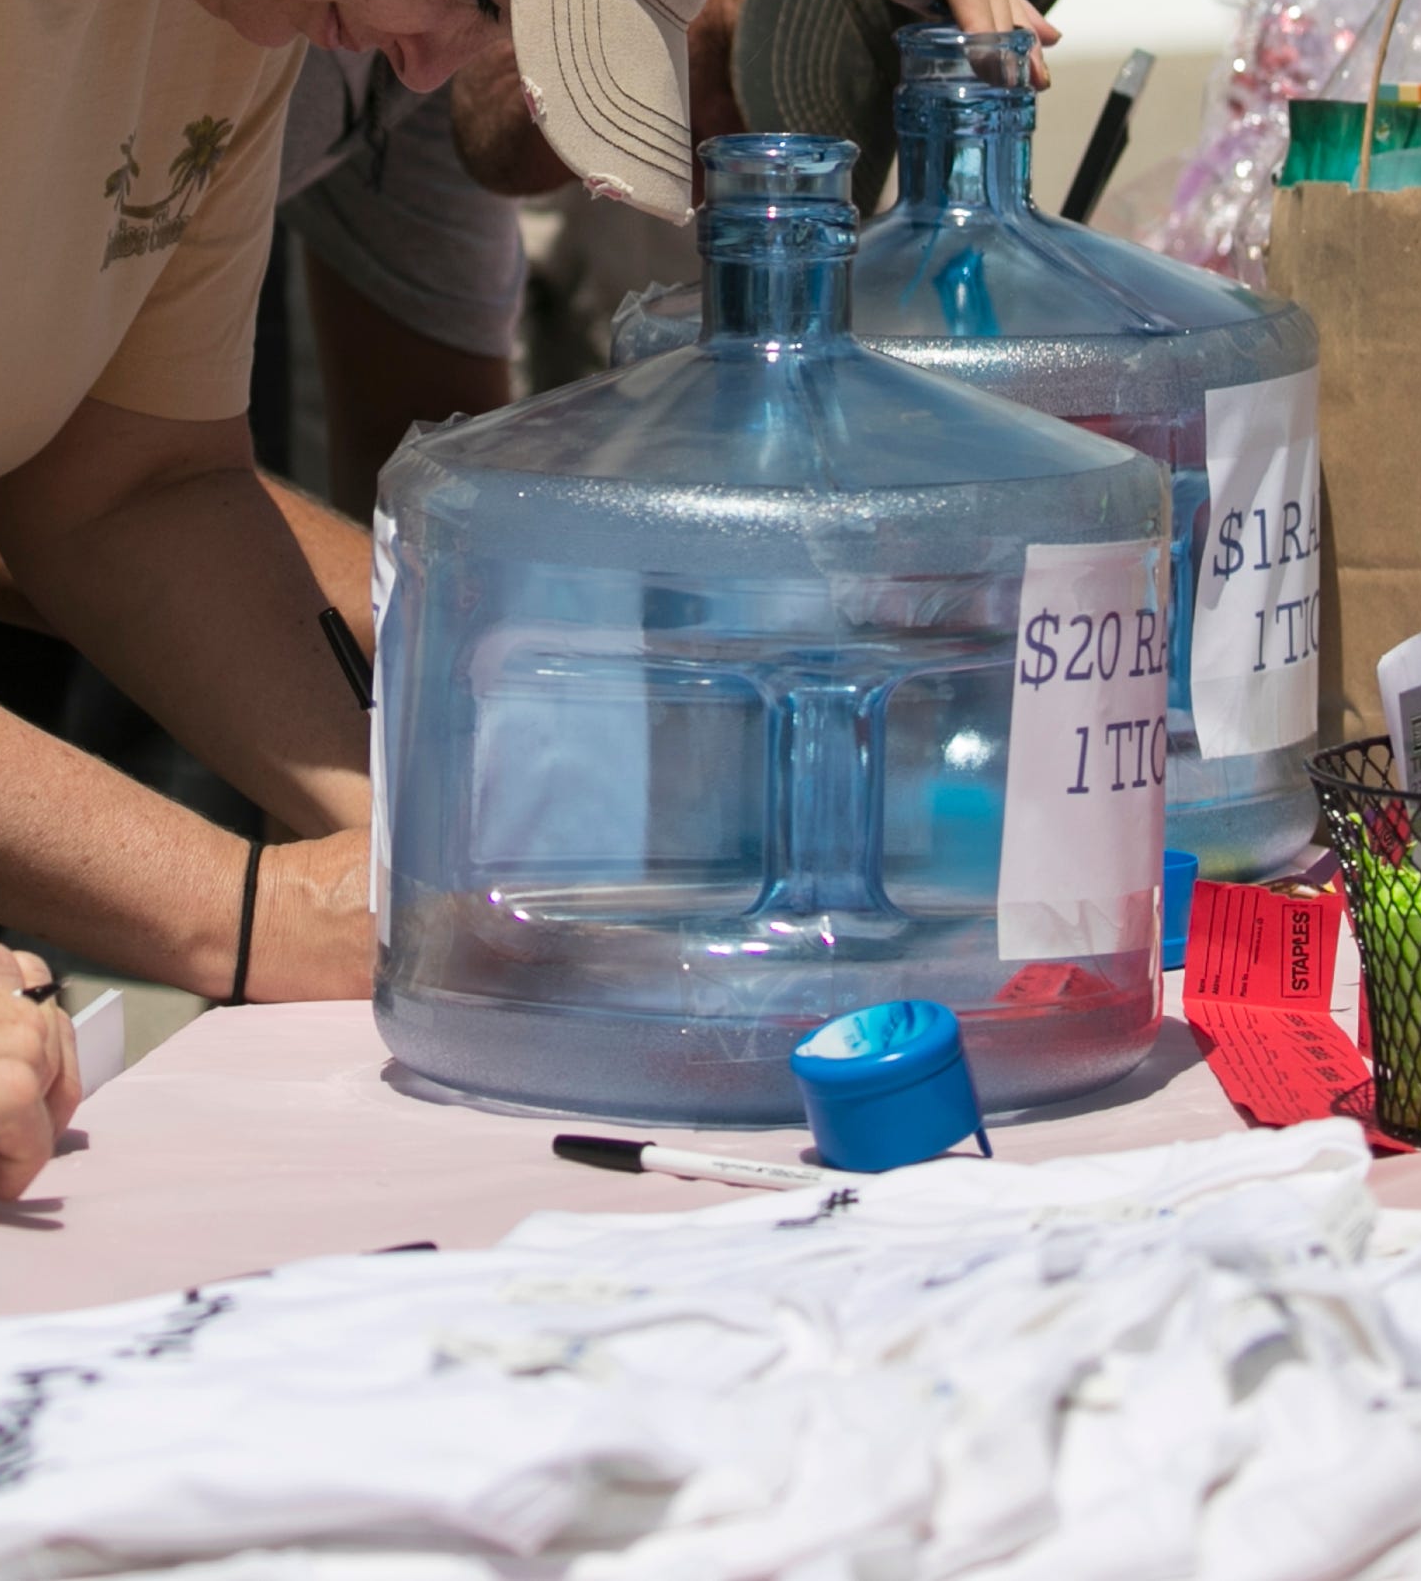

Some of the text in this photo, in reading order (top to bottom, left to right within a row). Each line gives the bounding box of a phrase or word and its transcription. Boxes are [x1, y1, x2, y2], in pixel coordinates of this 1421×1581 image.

[1212, 507, 1272, 582] $1
[1020, 607, 1121, 691] $20
[1067, 726, 1089, 794] 1
[1291, 910, 1310, 991] STAPLES
